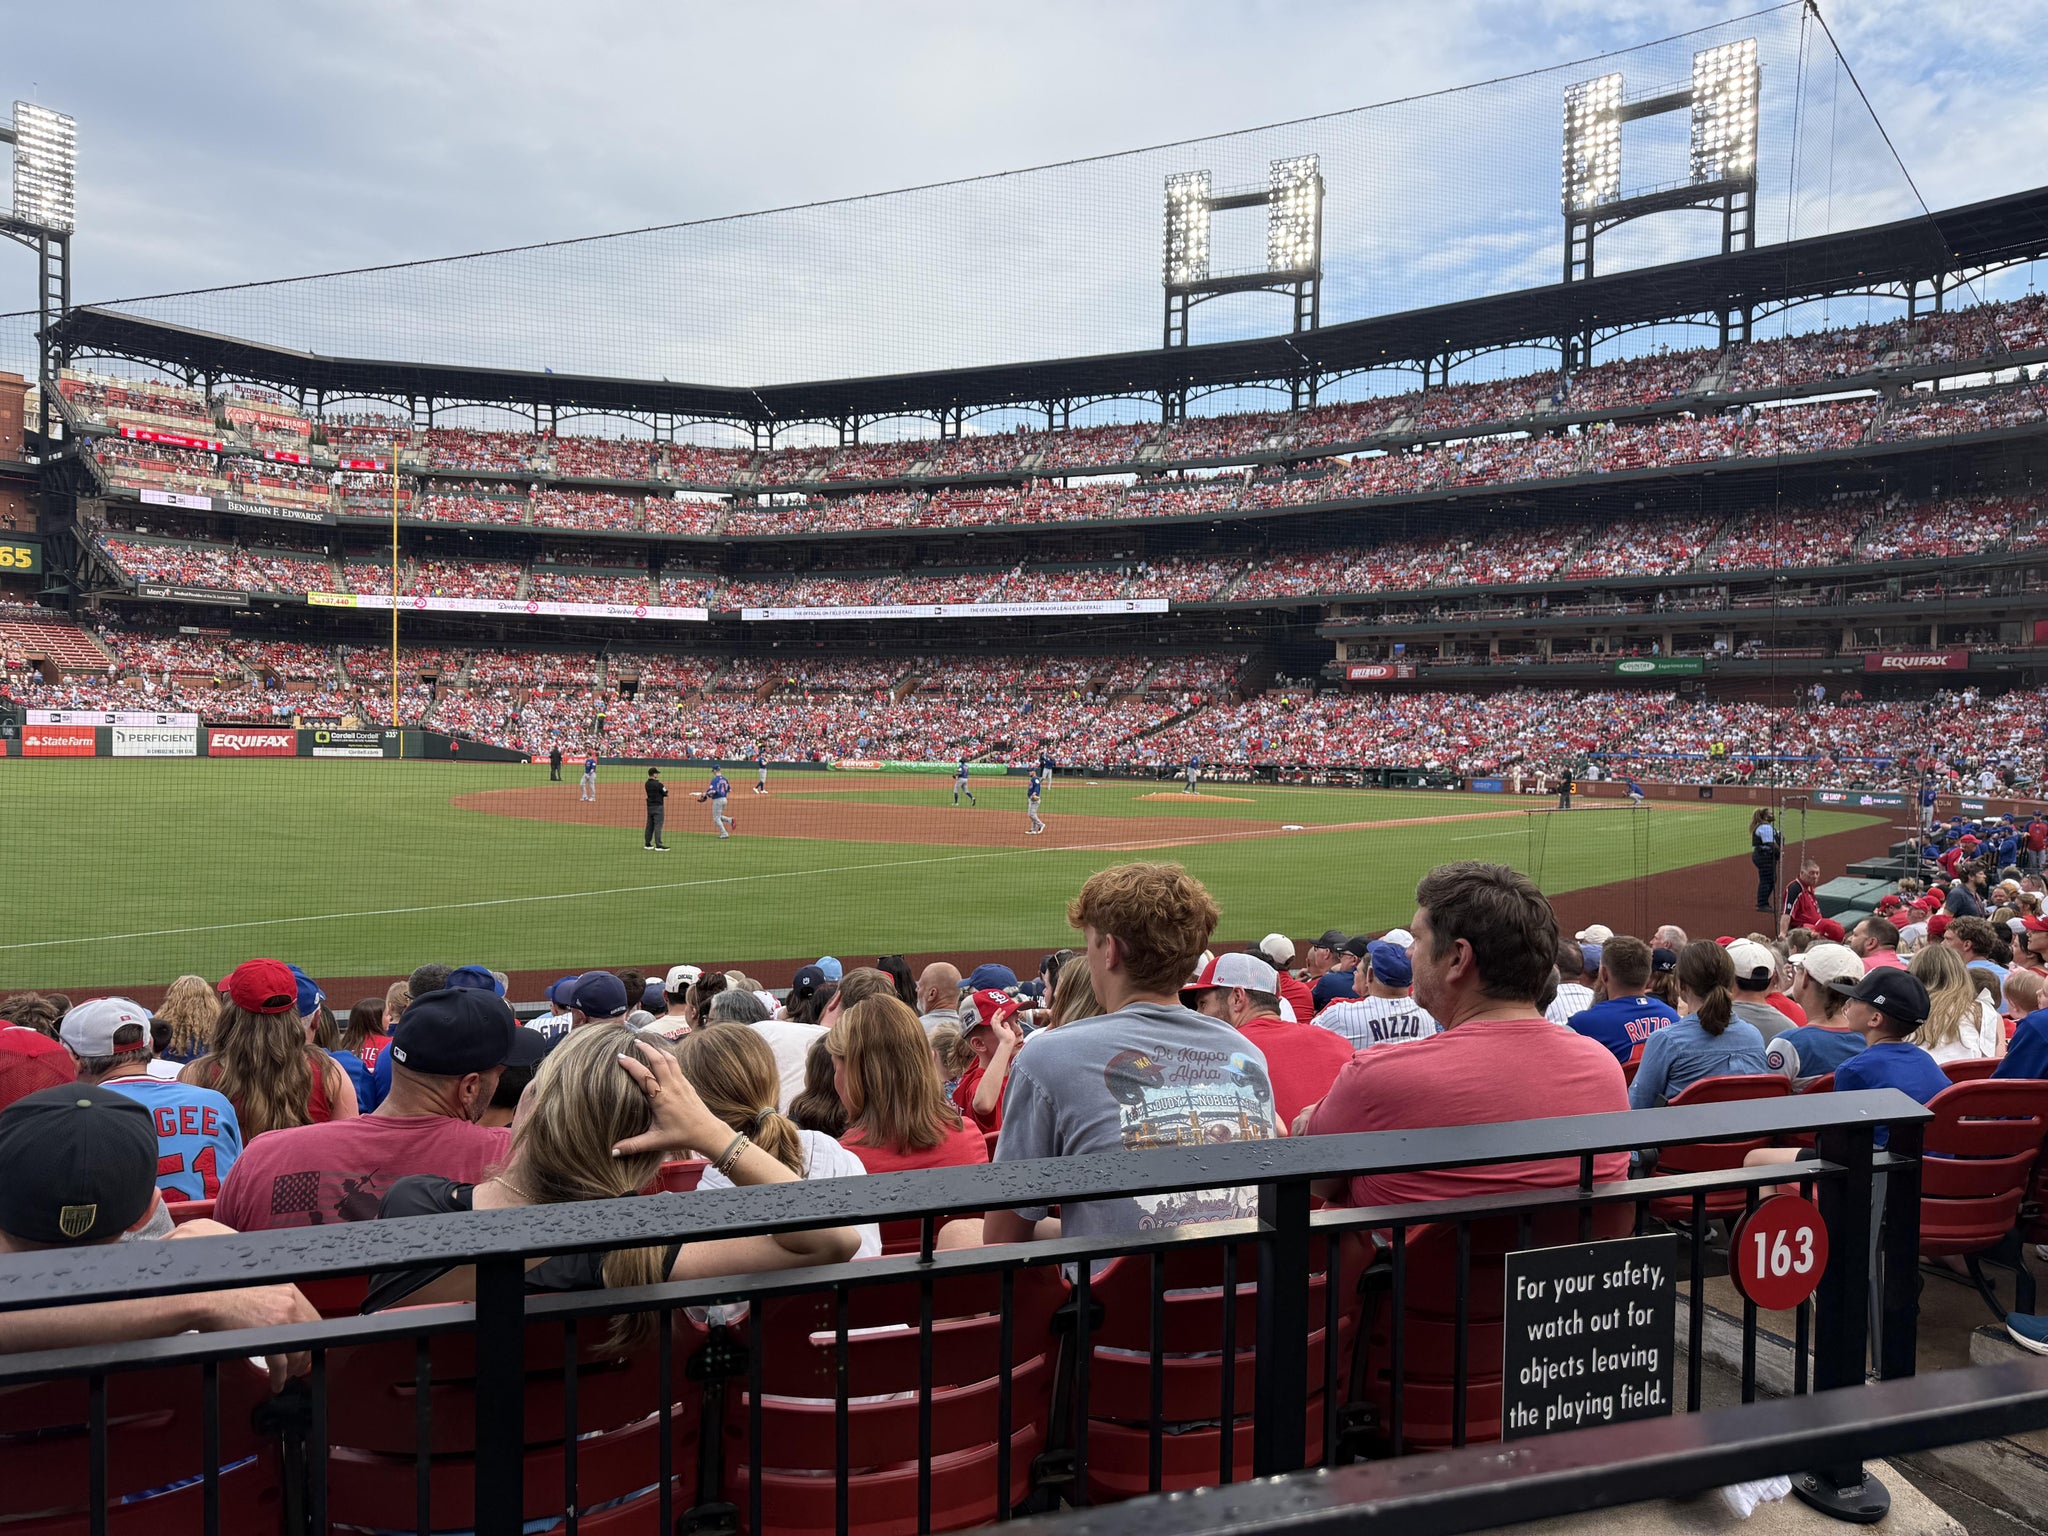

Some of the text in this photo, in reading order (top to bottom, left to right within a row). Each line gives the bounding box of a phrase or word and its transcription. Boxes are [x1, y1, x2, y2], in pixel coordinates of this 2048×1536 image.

[234, 384, 283, 400] BUDWEISER
[260, 413, 307, 428] BUDWEISER
[228, 501, 271, 516] BENJAMIN
[273, 507, 280, 516] F.
[146, 588, 165, 597] Mercy
[1882, 655, 1948, 669] EQUIFAX
[41, 736, 94, 747] State Farm
[128, 733, 195, 742] PERFICIENT
[211, 733, 290, 750] EQUIFAX
[331, 731, 379, 740] Cordell Cordell
[1368, 1016, 1420, 1041] RIZZO
[1624, 1017, 1671, 1043] RIZZO
[1151, 1045, 1174, 1063] Pi
[1178, 1047, 1229, 1067] Kappa
[1169, 1065, 1221, 1086] Alpha
[1198, 1095, 1232, 1106] NOBLE
[1754, 1226, 1814, 1278] 163
[1516, 1259, 1666, 1304] For your safety,
[1527, 1300, 1654, 1341] watch out for
[1519, 1343, 1659, 1389] objects leaving
[1509, 1379, 1667, 1430] the playing field.
